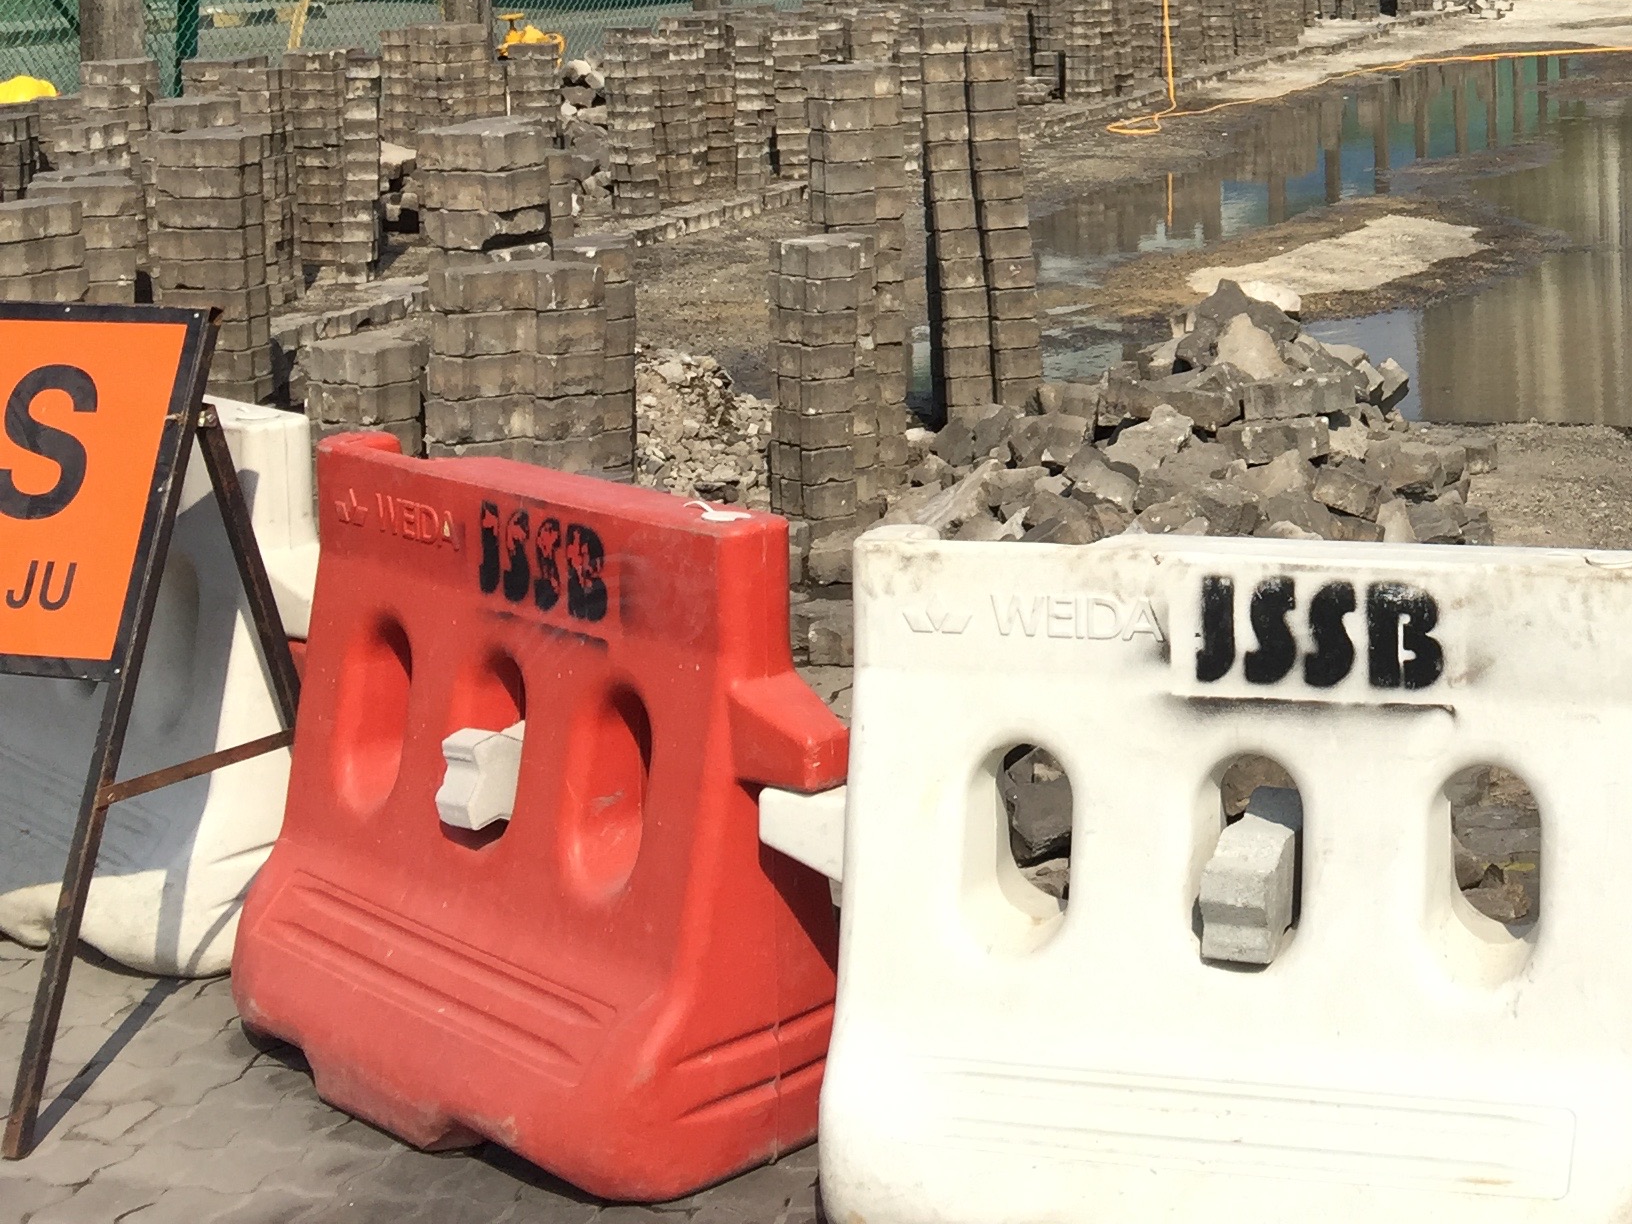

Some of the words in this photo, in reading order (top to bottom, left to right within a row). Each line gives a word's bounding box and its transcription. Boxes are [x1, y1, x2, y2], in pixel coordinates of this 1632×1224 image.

[374, 492, 461, 552] WEIDA
[989, 593, 1165, 643] WEIDA
[1195, 574, 1444, 690] JSSB
